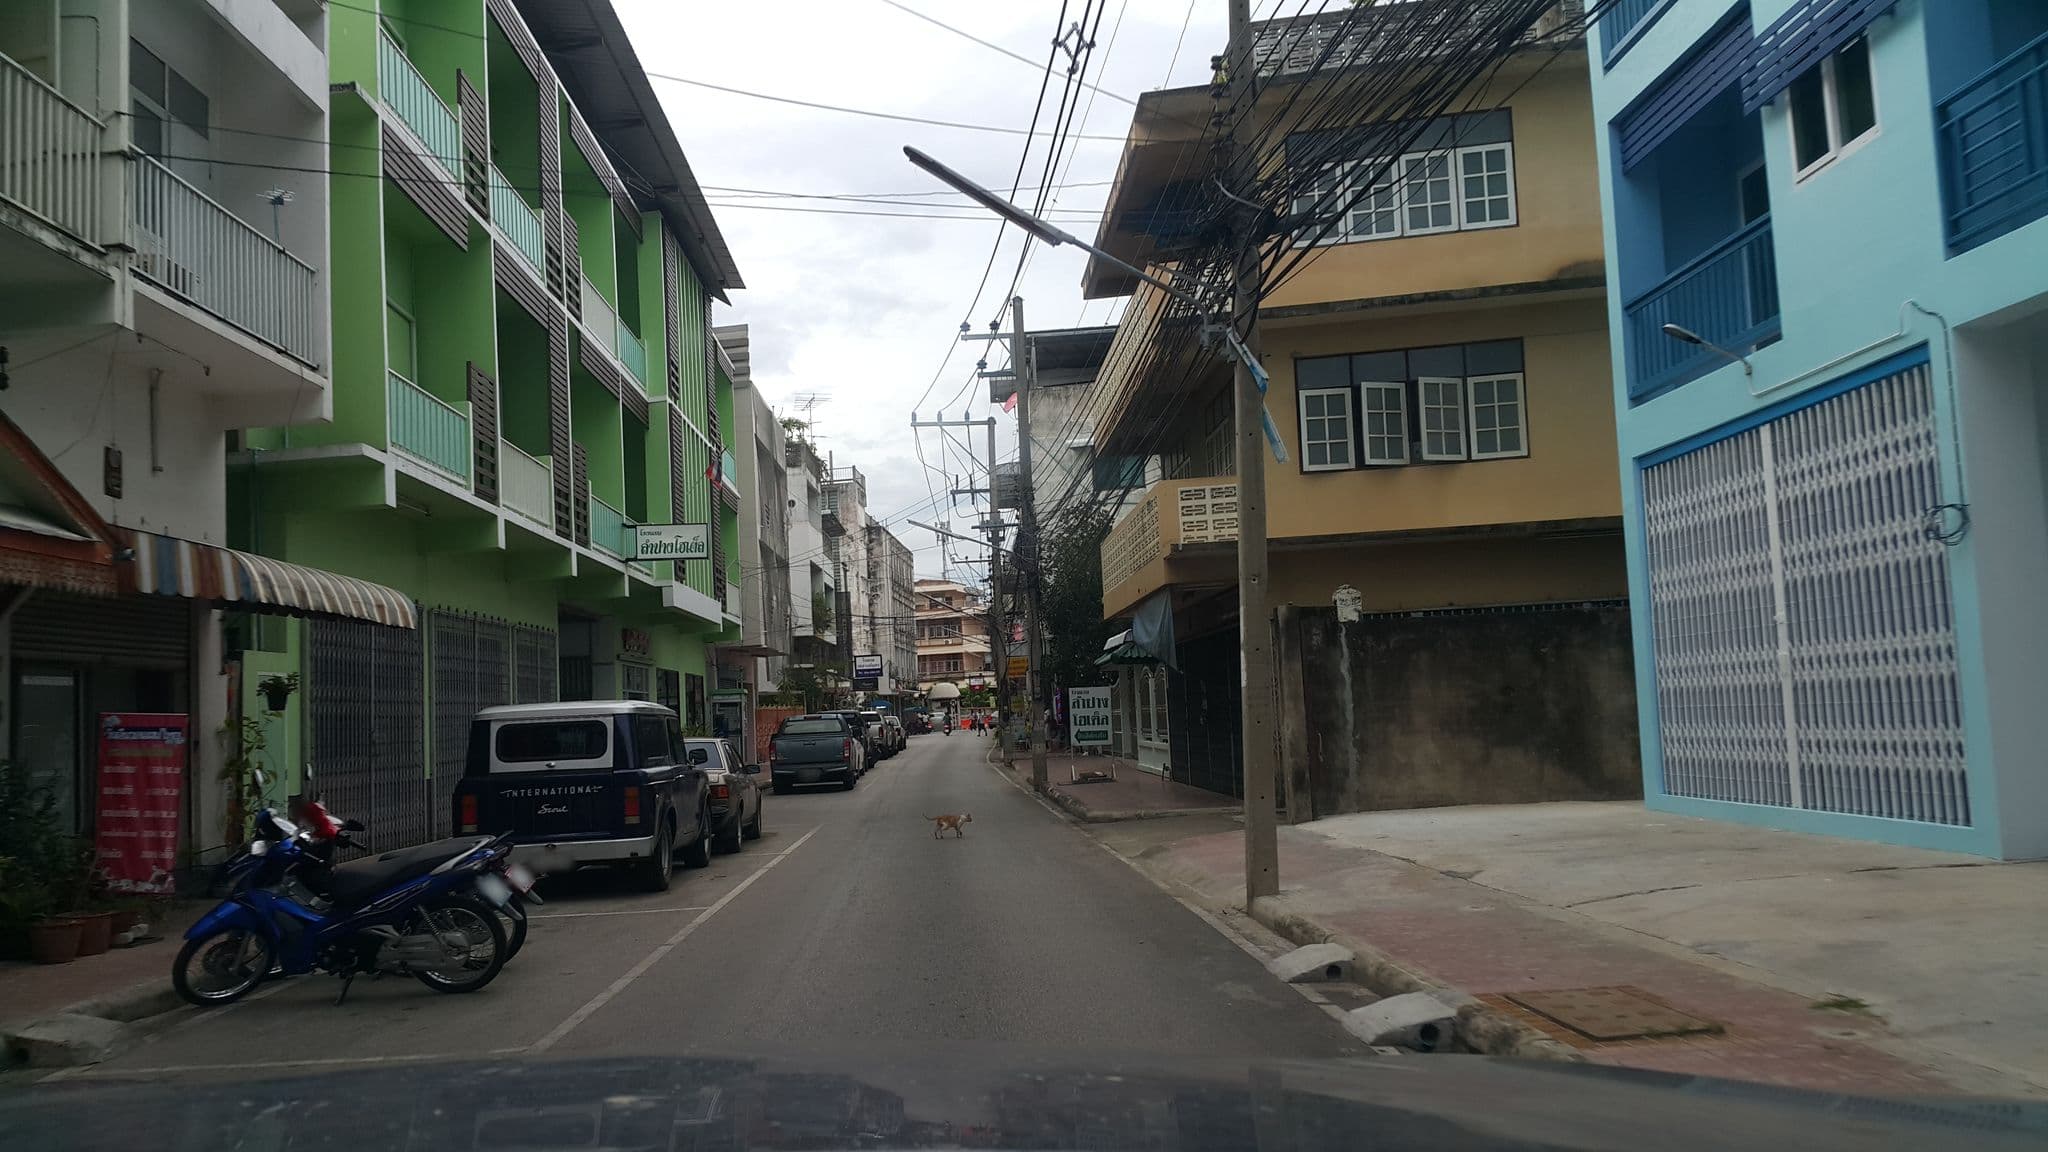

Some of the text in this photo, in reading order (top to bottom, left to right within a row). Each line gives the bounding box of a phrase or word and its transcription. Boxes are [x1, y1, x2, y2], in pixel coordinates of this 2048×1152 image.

[641, 535, 705, 554] ลำปางโฮเต็ล
[1071, 696, 1110, 709] ลำปาง
[500, 786, 604, 798] INTERNATIONAL
[537, 803, 569, 814] Scout
